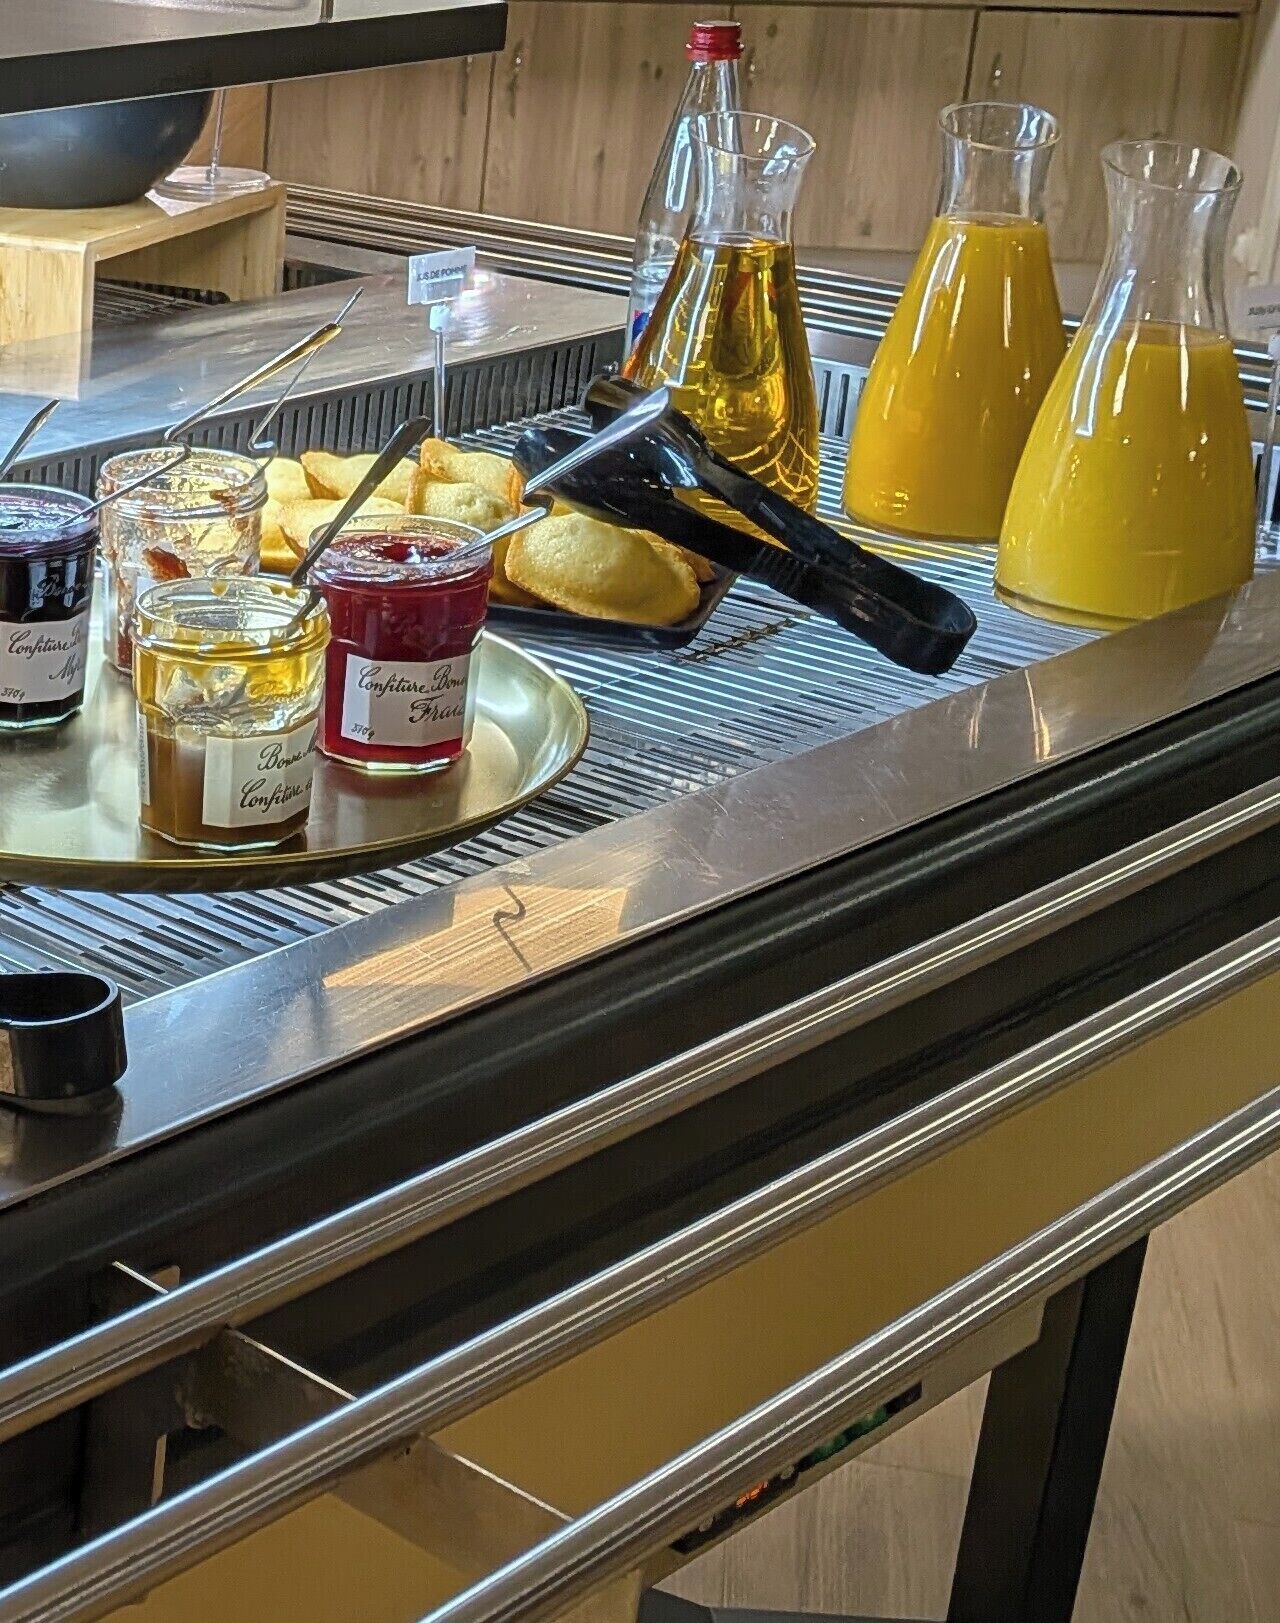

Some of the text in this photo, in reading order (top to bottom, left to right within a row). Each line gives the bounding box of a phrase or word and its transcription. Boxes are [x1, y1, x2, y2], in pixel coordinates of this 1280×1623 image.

[430, 269, 440, 279] DE
[441, 264, 467, 276] POMME
[8, 629, 70, 659] Confiture
[357, 664, 430, 698] Confiture
[239, 778, 303, 813] Confiture
